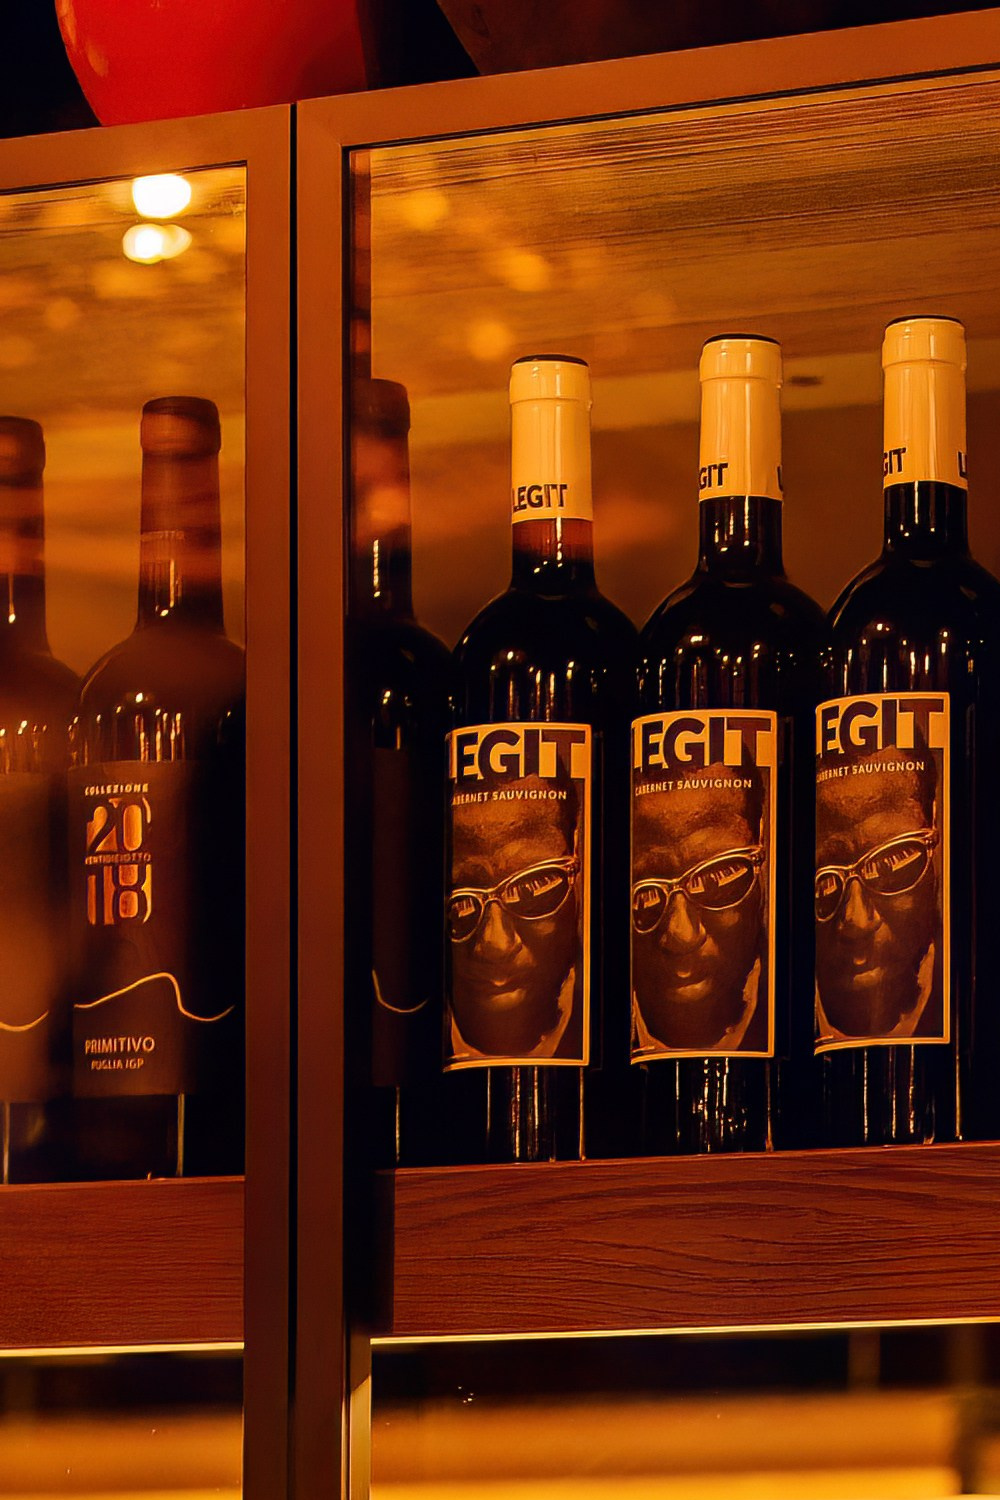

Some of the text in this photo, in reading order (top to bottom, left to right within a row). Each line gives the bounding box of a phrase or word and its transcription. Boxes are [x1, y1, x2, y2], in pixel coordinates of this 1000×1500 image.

[512, 483, 568, 513] LEGIT
[820, 698, 945, 757] EGIT
[852, 761, 925, 775] SAUVIGNON
[492, 789, 567, 801] SAUVIGNON
[635, 779, 752, 797] CABERNET SAUVIGNON
[84, 1036, 156, 1055] PRIMITIVO
[91, 1058, 145, 1070] PUGLIA IGP
